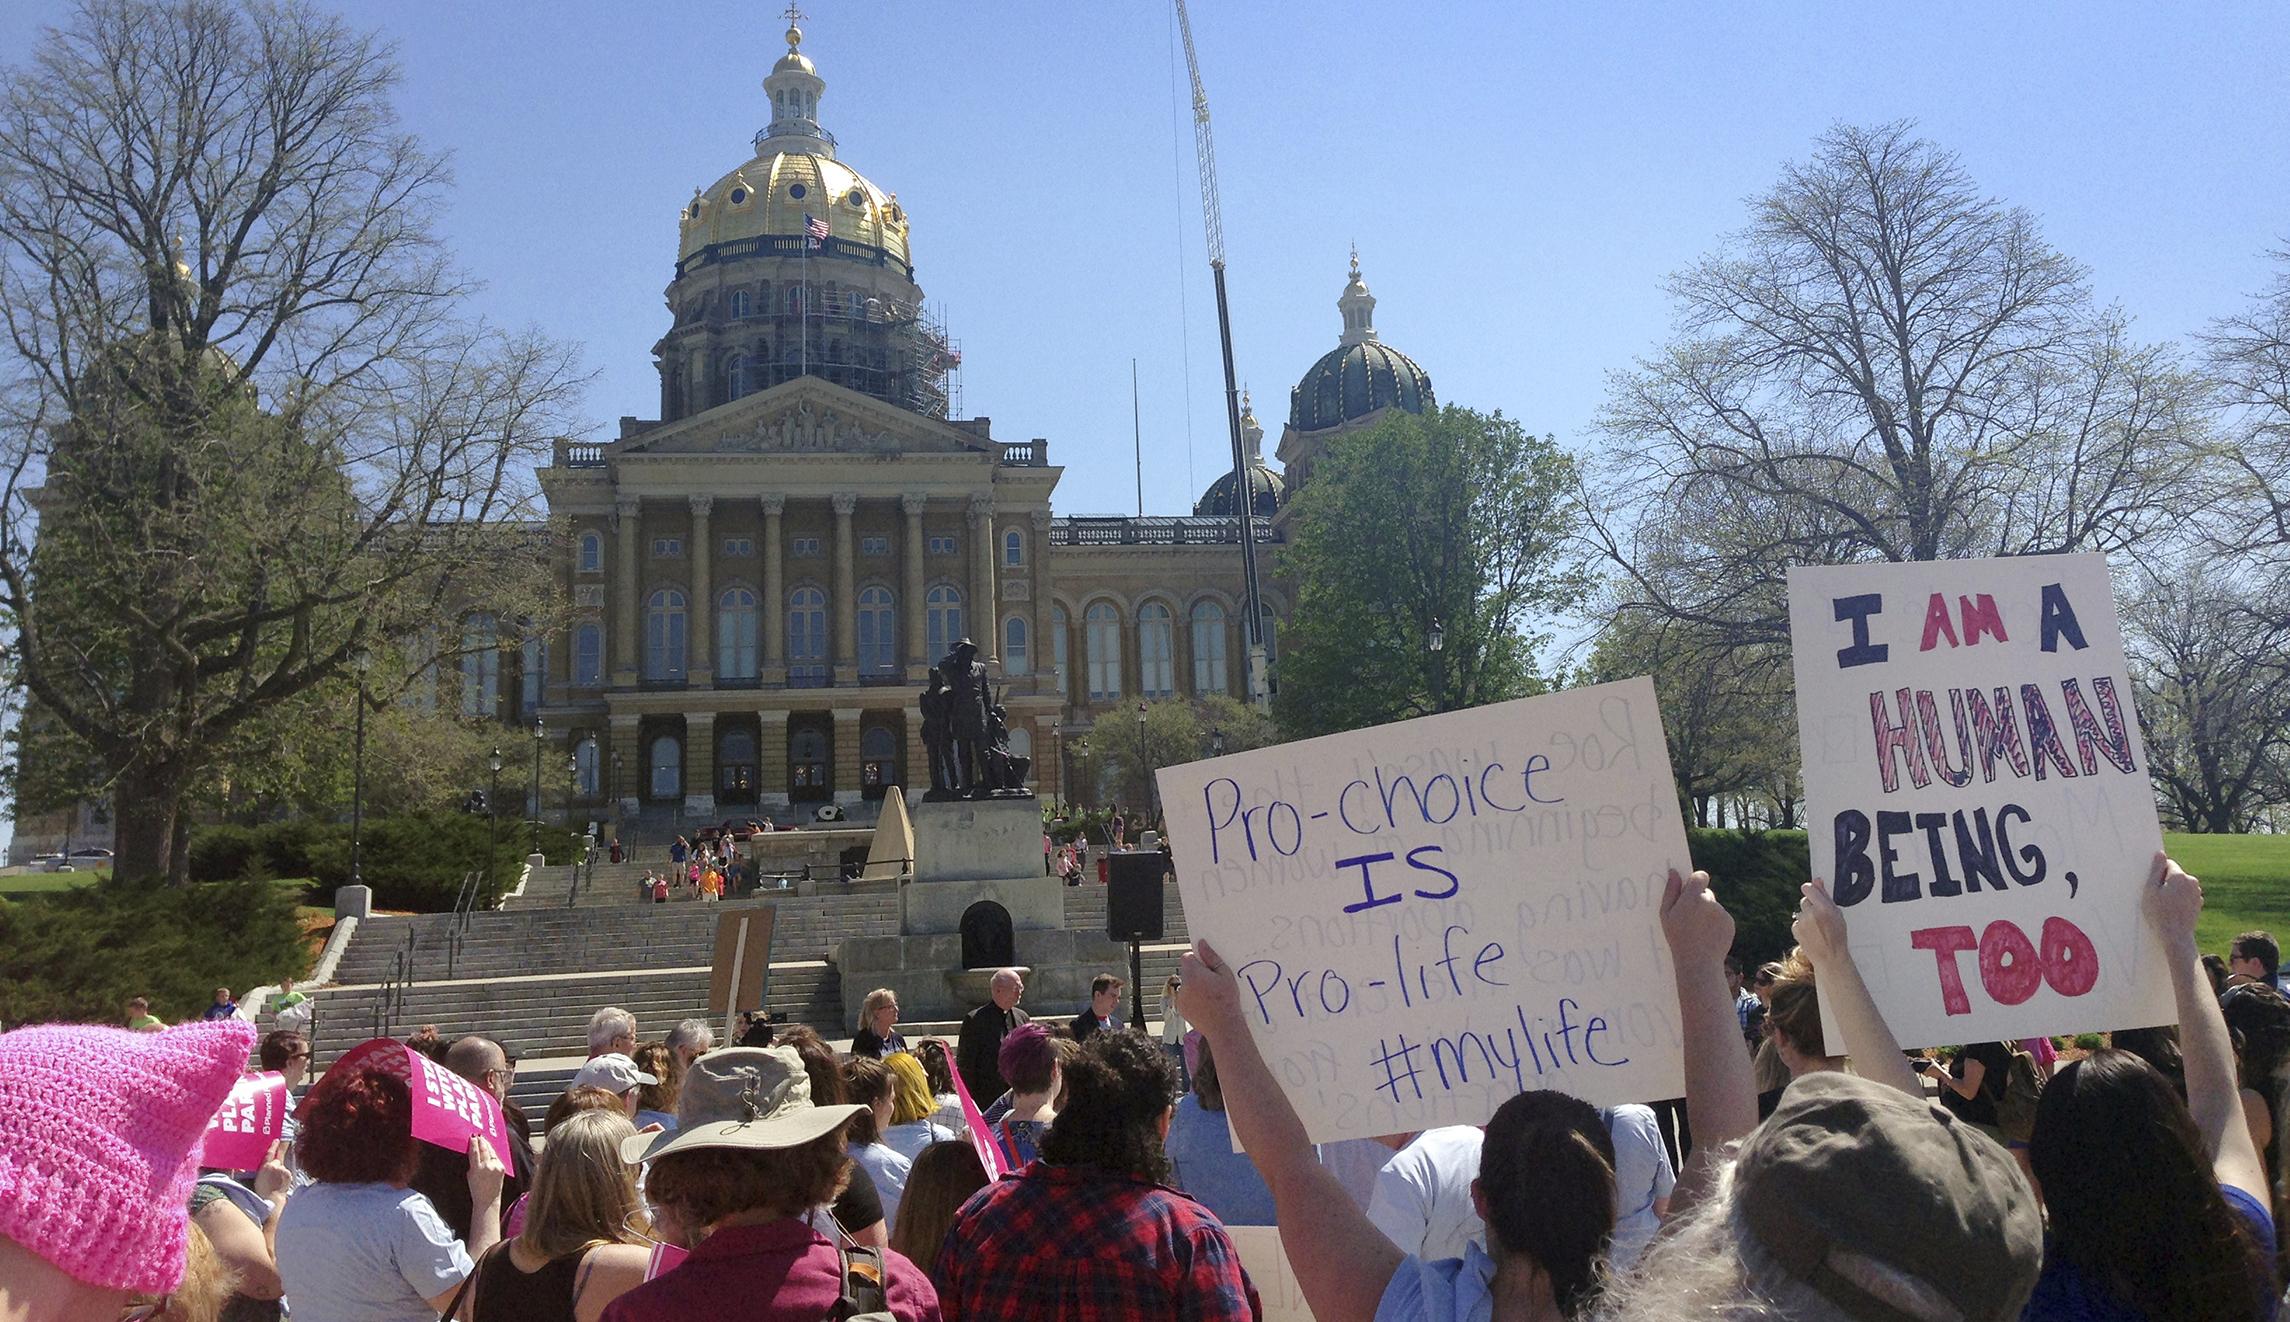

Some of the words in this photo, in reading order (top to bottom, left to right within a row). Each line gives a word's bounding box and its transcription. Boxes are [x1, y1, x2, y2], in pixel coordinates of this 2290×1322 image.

[1833, 593, 1888, 668] I
[1920, 592, 2009, 652] AM
[2040, 582, 2089, 653] A
[1870, 676, 2137, 793] HUMAN
[1204, 754, 1564, 864] Pro-choice
[1832, 804, 2079, 908] BEING,
[1335, 845, 1458, 913] IS
[1237, 925, 1509, 1024] Pro-life
[1911, 916, 2100, 1016] TOO
[1370, 998, 1629, 1103] #mylife
